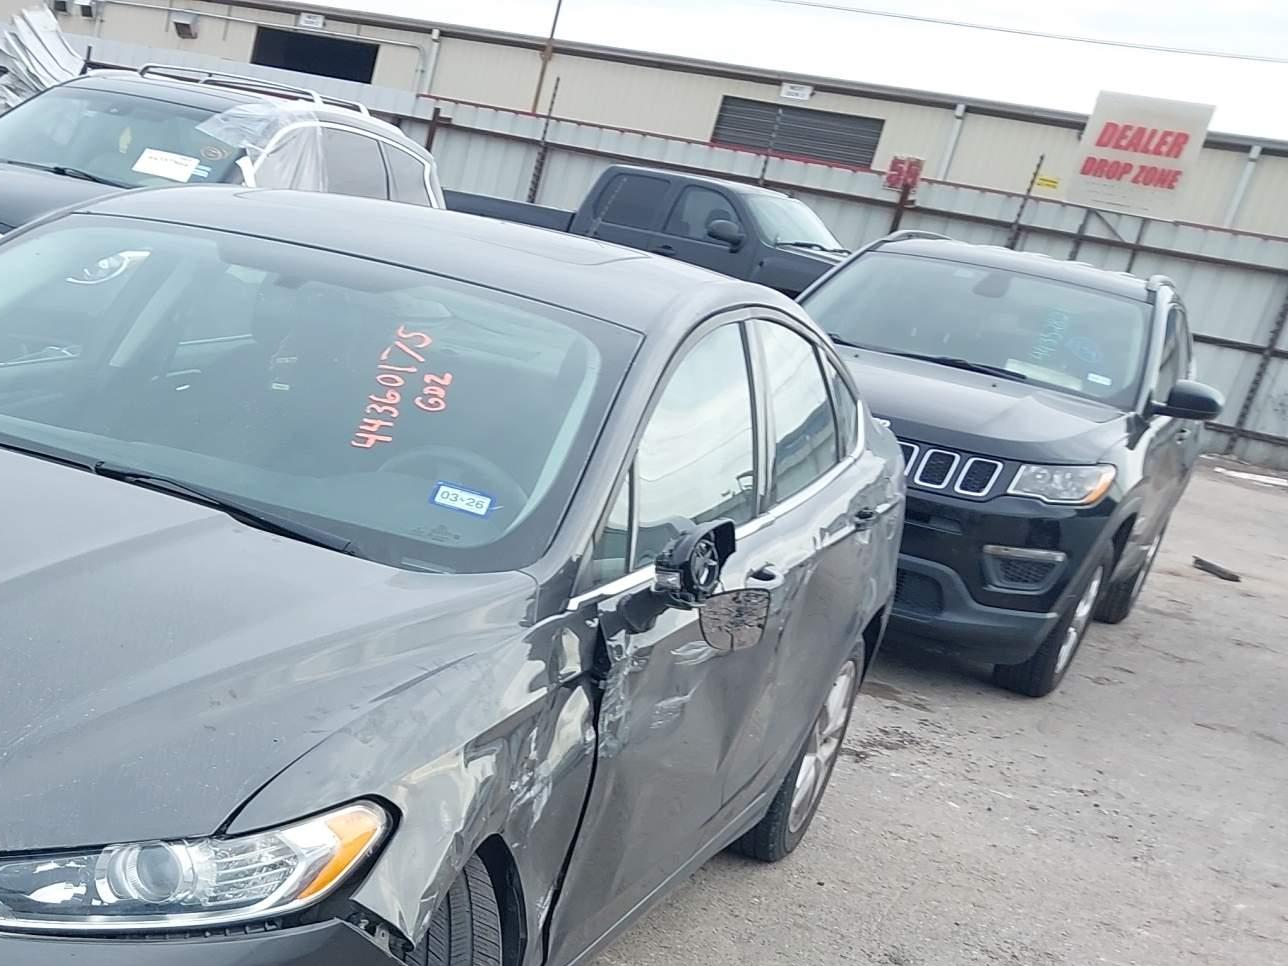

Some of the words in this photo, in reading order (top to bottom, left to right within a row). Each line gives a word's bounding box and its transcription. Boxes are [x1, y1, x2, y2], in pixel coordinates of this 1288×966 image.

[1095, 121, 1190, 159] DEALER
[1080, 156, 1133, 181] DROP
[1131, 164, 1183, 190] ZONE
[350, 324, 433, 449] 44360175
